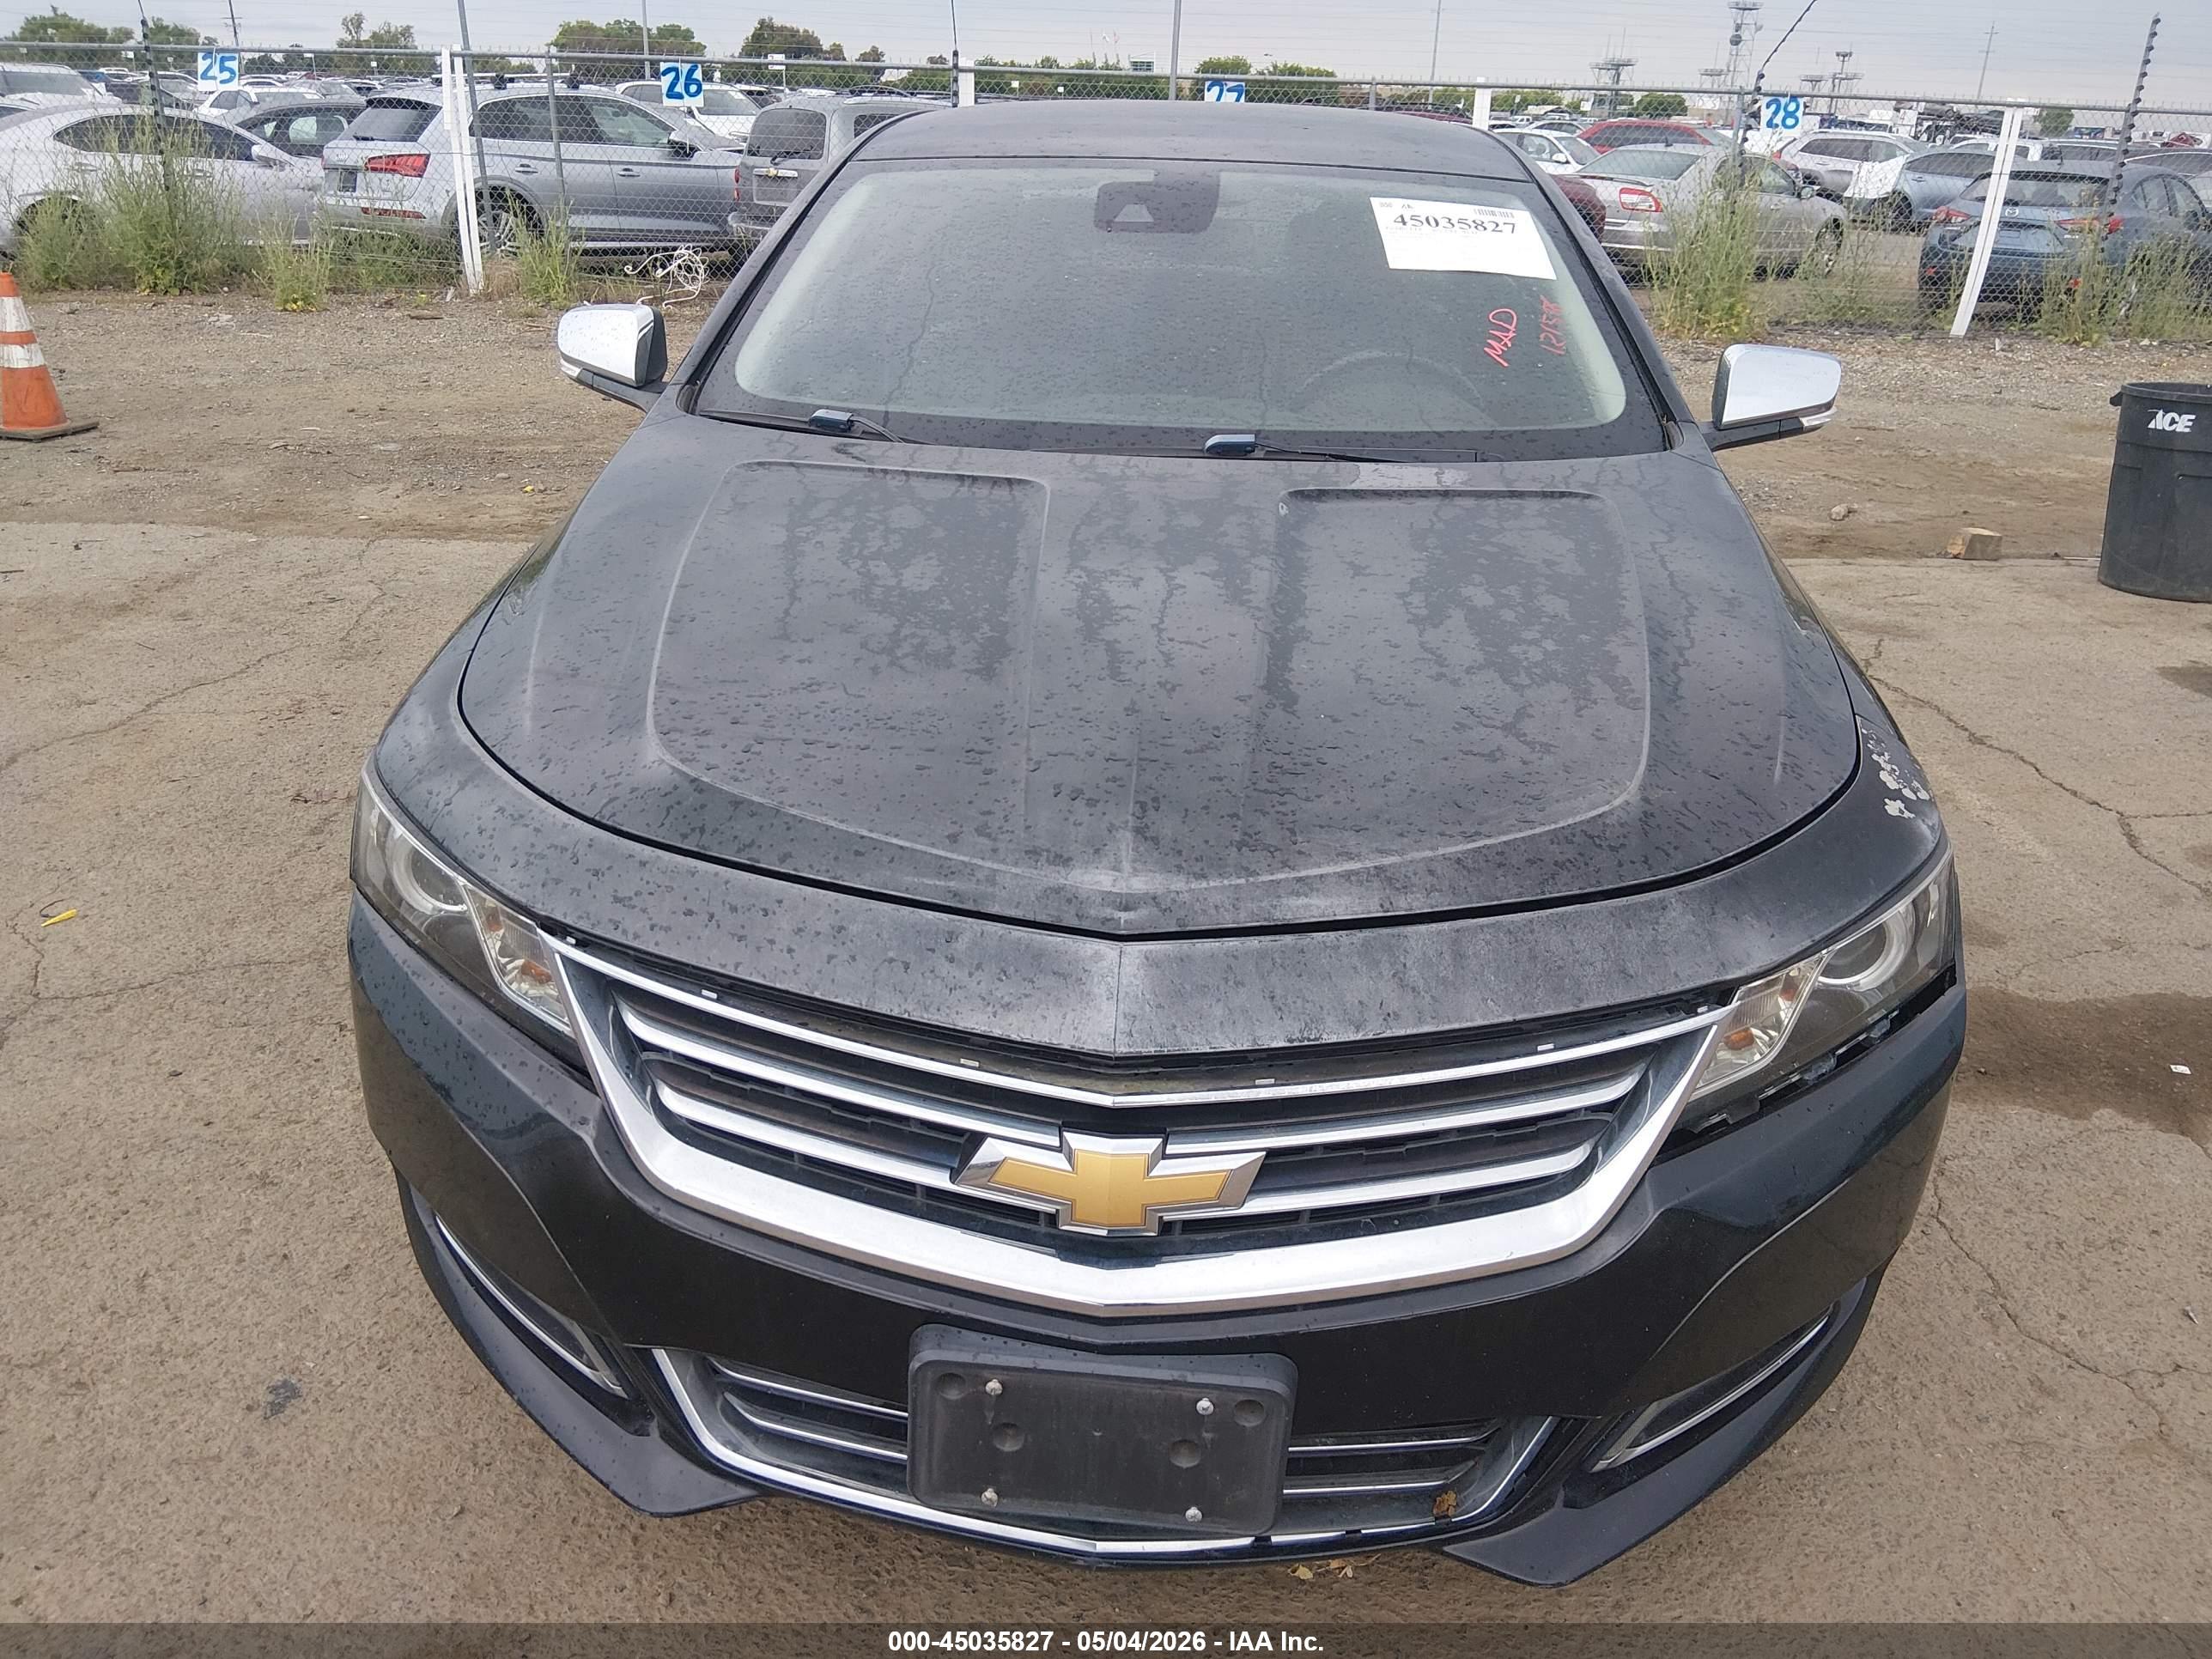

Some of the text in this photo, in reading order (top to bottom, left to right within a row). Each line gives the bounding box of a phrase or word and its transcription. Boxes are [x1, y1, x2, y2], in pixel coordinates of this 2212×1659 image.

[200, 52, 237, 84] 25
[661, 64, 702, 100] 26
[1765, 96, 1800, 129] 28
[1394, 214, 1516, 234] 45035827
[2147, 409, 2196, 432] ACE
